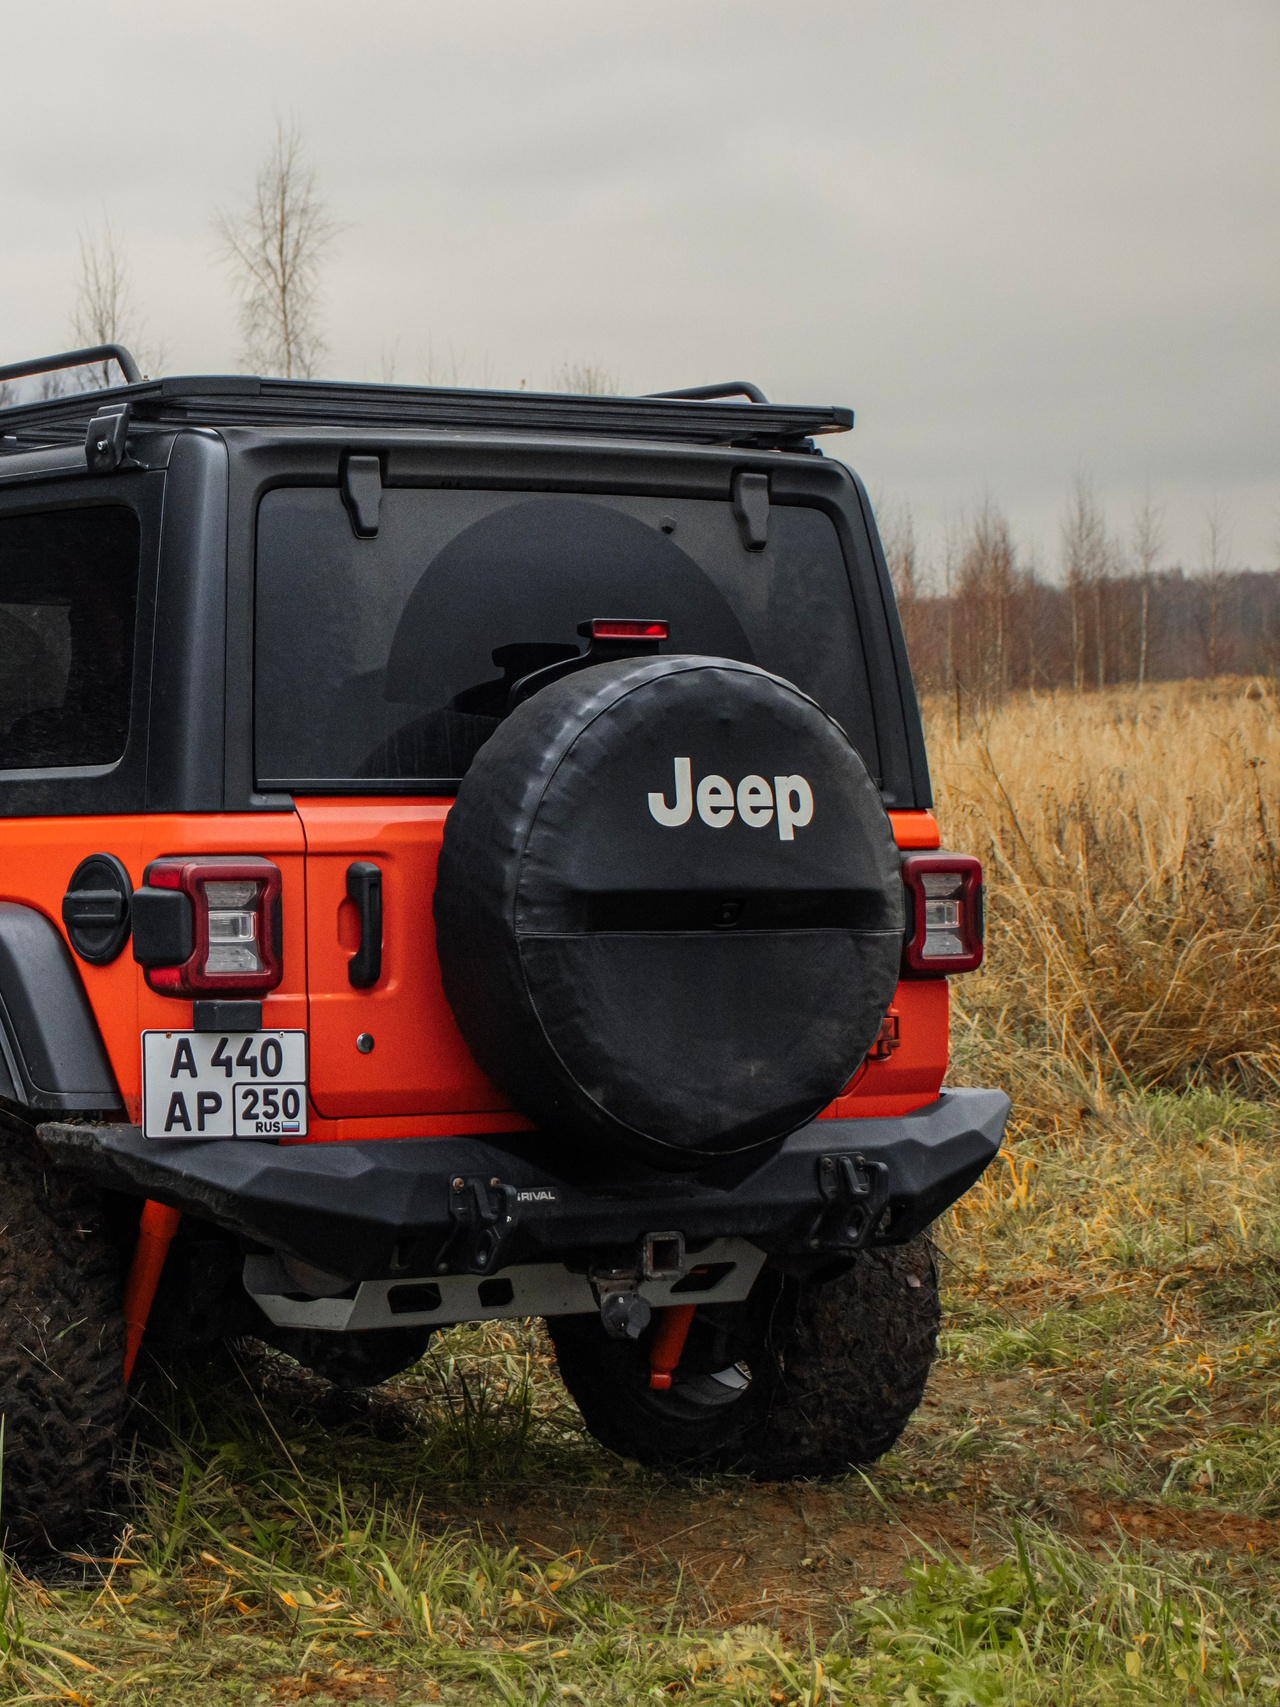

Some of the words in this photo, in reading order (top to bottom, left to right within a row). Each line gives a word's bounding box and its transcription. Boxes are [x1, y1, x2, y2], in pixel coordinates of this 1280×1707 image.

[648, 757, 814, 840] Jeep
[170, 1037, 198, 1078] A
[210, 1037, 283, 1078] 440
[164, 1091, 223, 1132] AP
[241, 1088, 300, 1120] 250
[255, 1121, 280, 1133] RUS
